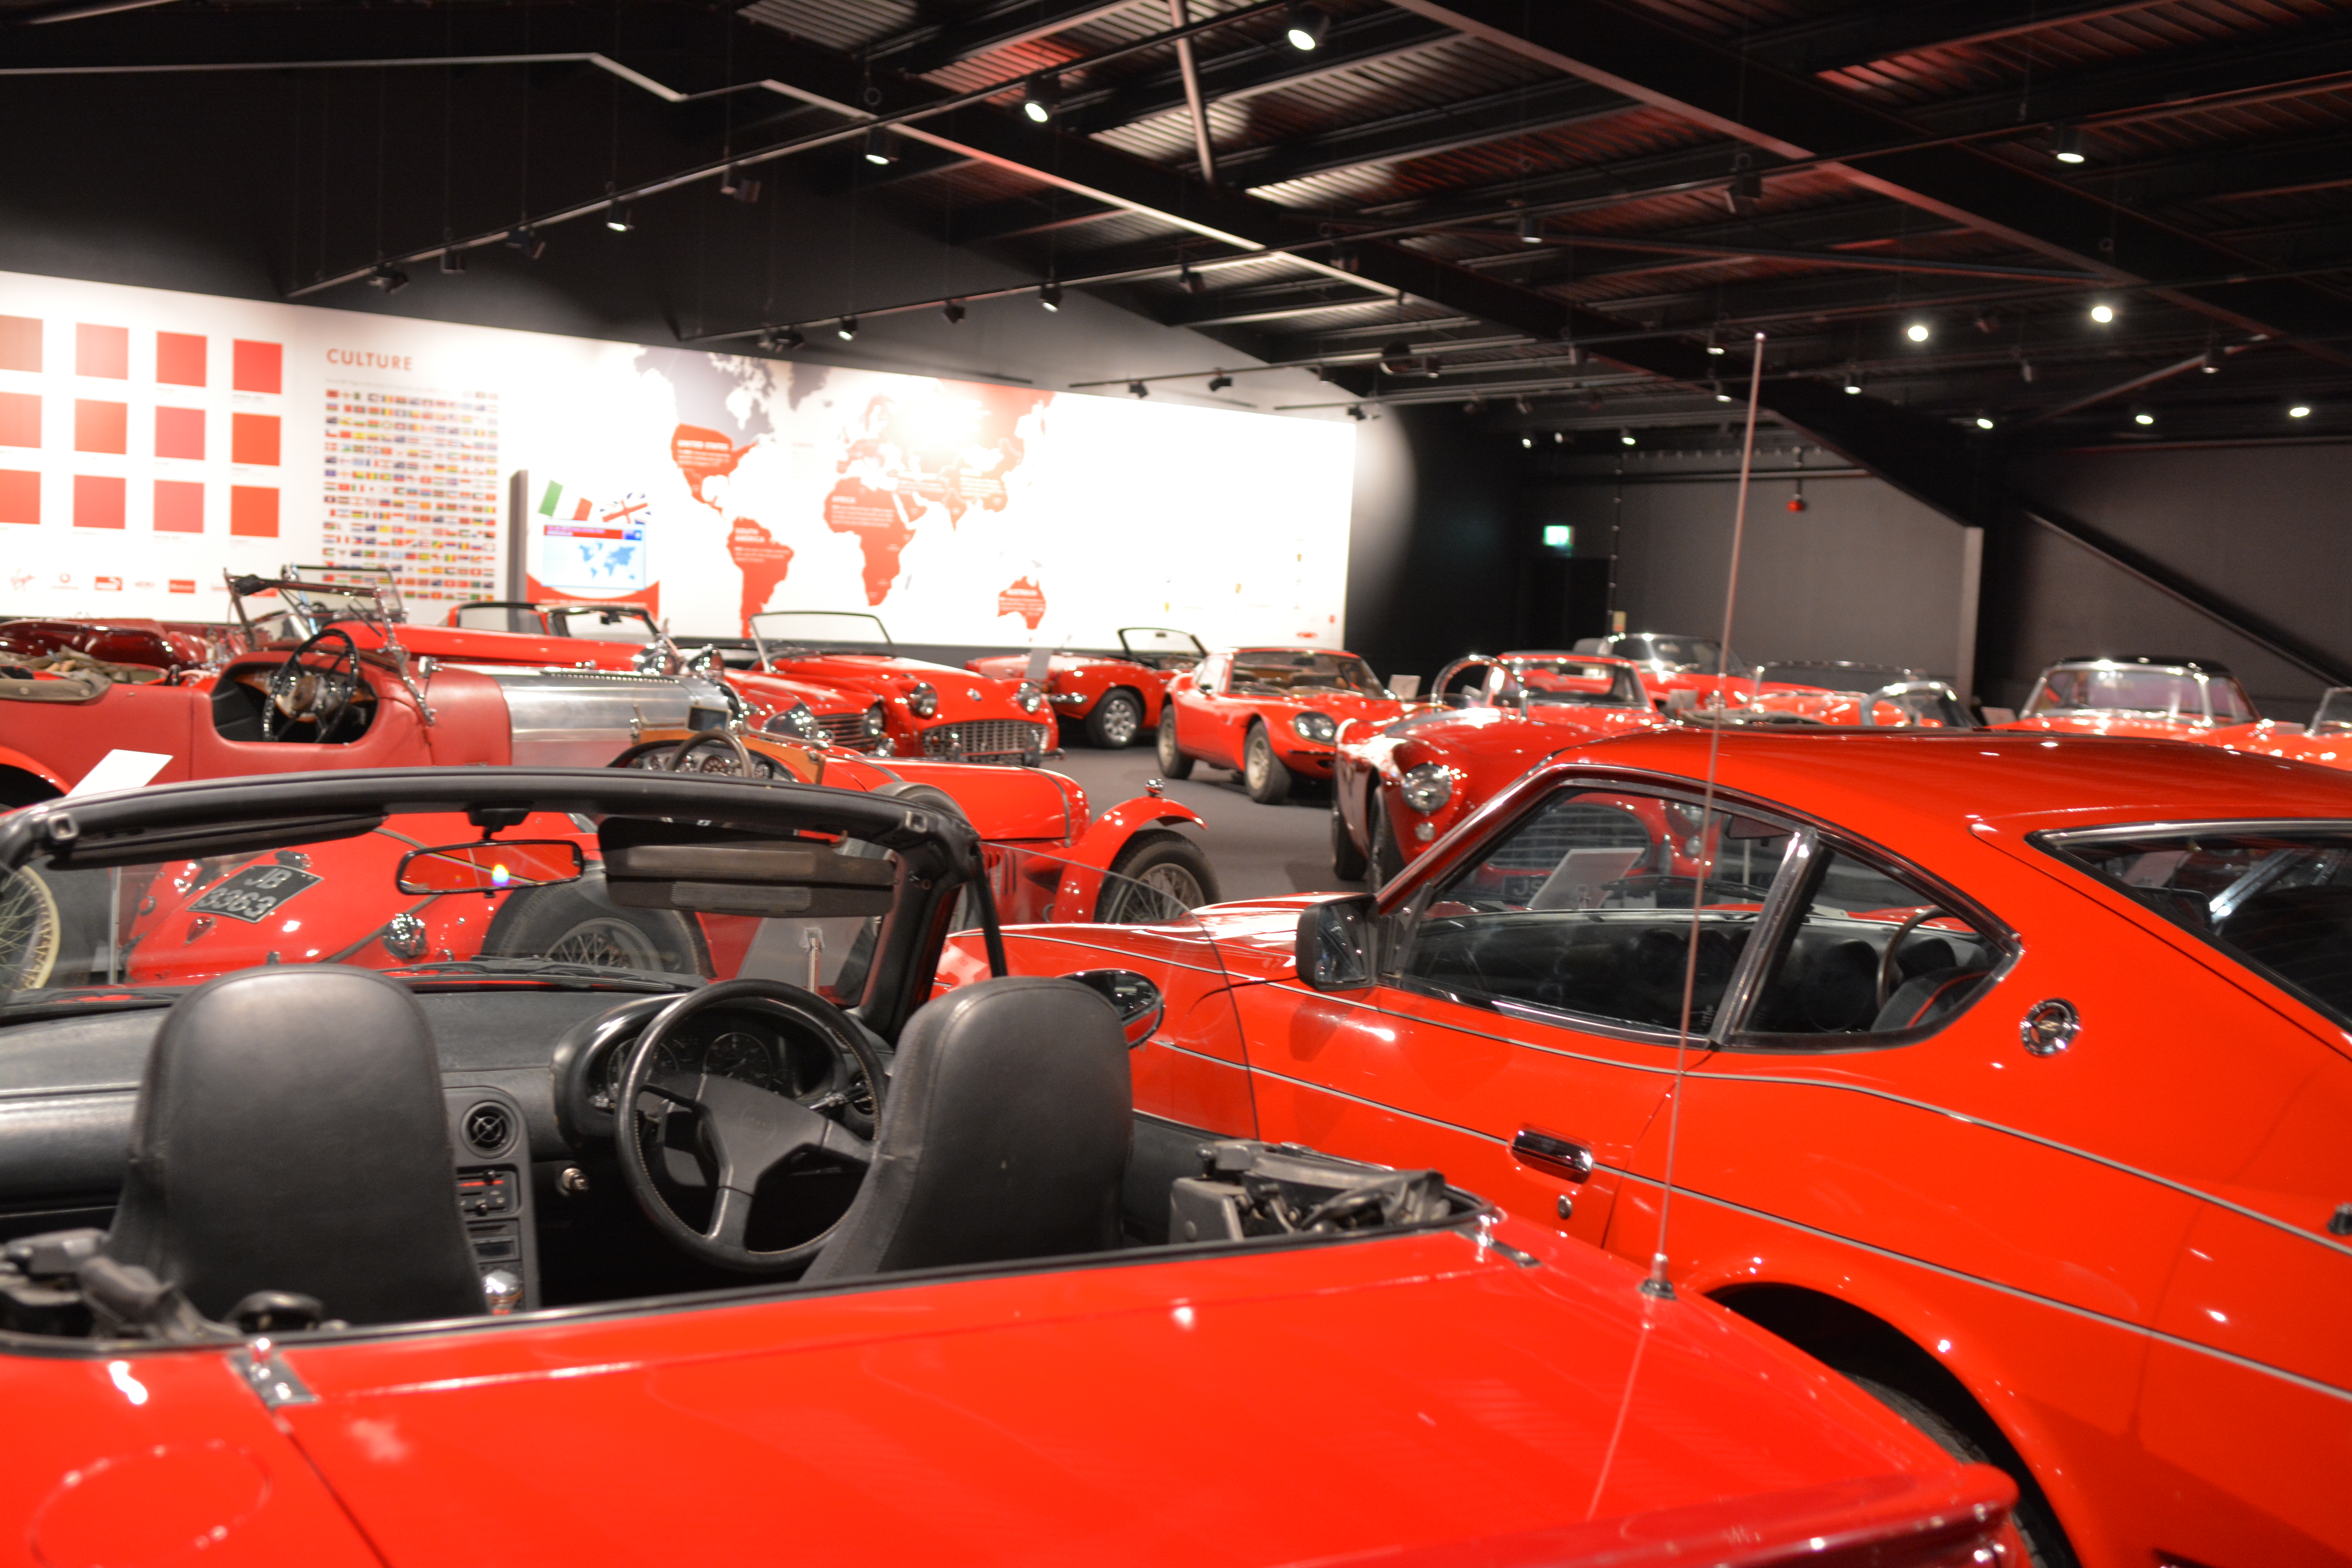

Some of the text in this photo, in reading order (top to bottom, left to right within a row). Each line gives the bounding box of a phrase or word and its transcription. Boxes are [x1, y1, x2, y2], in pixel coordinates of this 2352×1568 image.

[327, 348, 412, 370] CULTURE
[243, 868, 292, 889] JB
[196, 887, 277, 918] 3363
